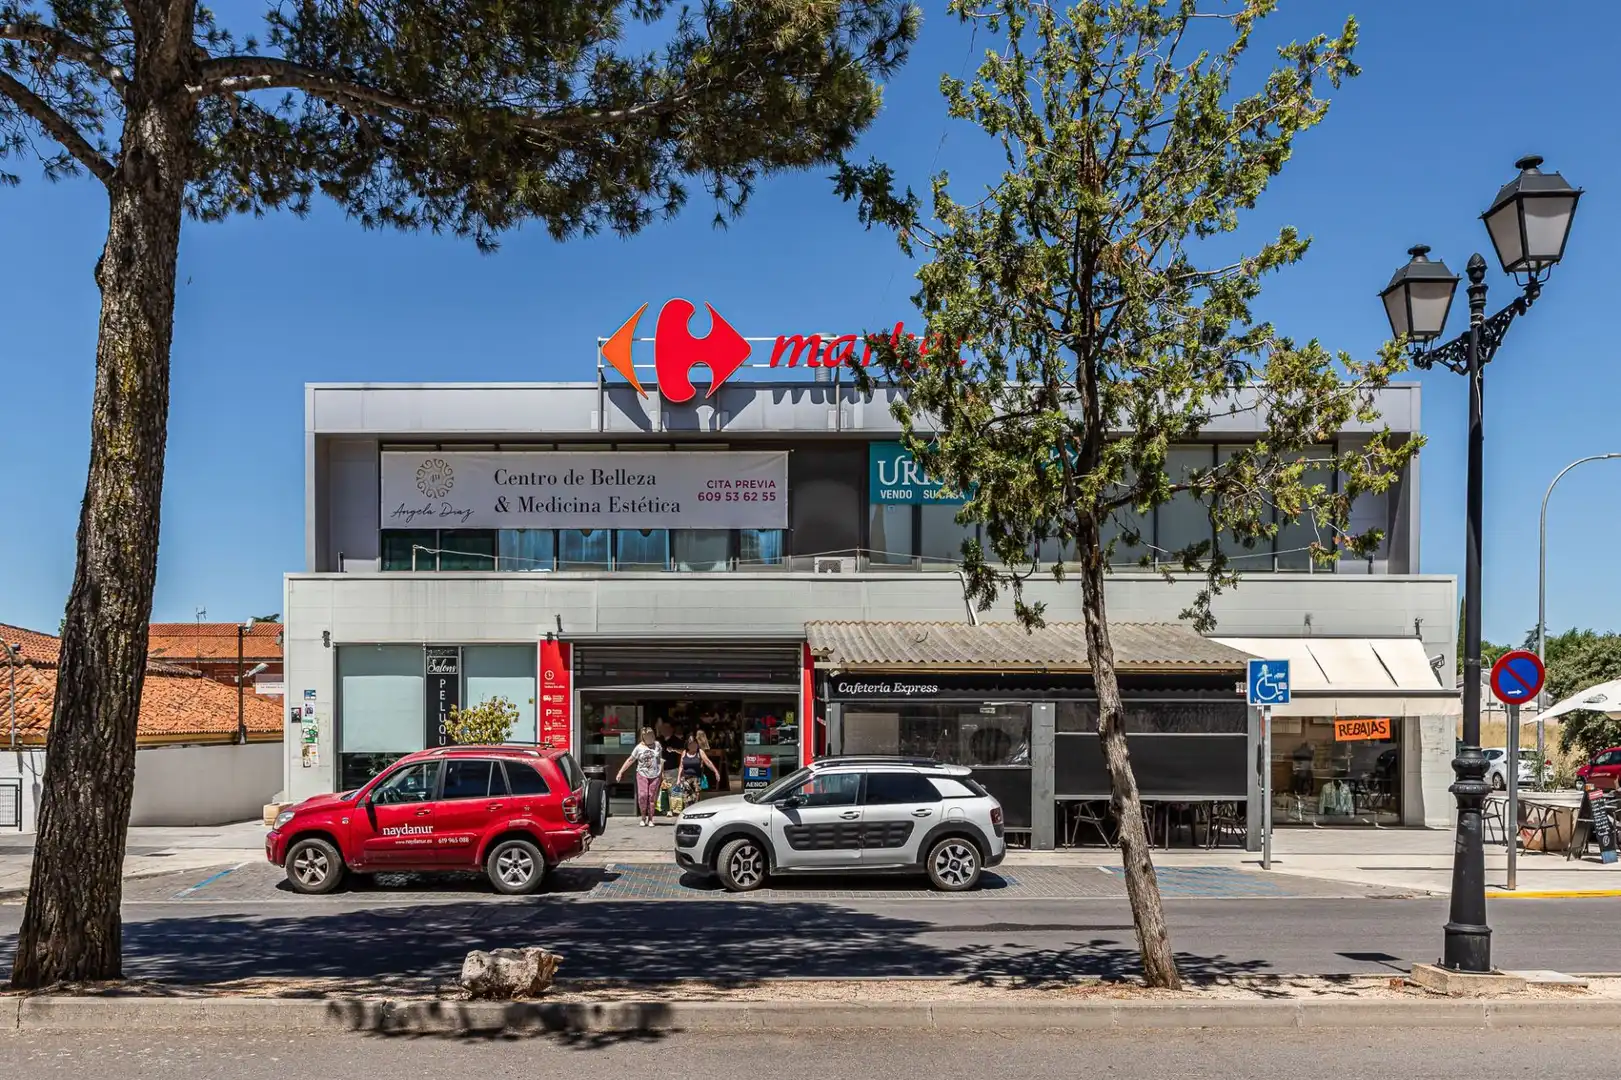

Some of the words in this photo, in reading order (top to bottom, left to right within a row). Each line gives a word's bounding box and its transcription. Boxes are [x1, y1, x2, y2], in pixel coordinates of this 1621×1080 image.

[494, 469, 557, 486] Centro
[563, 469, 584, 486] de
[590, 469, 656, 486] Belleza
[706, 480, 732, 489] CITA
[735, 480, 776, 489] PREVIA
[697, 492, 721, 501] 609
[725, 492, 739, 501] 53
[743, 492, 758, 501] 62
[762, 492, 776, 501] 55
[880, 489, 912, 499] VENDO
[923, 489, 936, 499] SU
[494, 496, 510, 513] &
[518, 496, 601, 513] Medicina
[609, 496, 680, 513] Estética
[838, 682, 891, 694] Cafetería
[892, 682, 938, 695] Express
[1338, 721, 1386, 737] REBAJAS
[382, 823, 434, 838] naydanur
